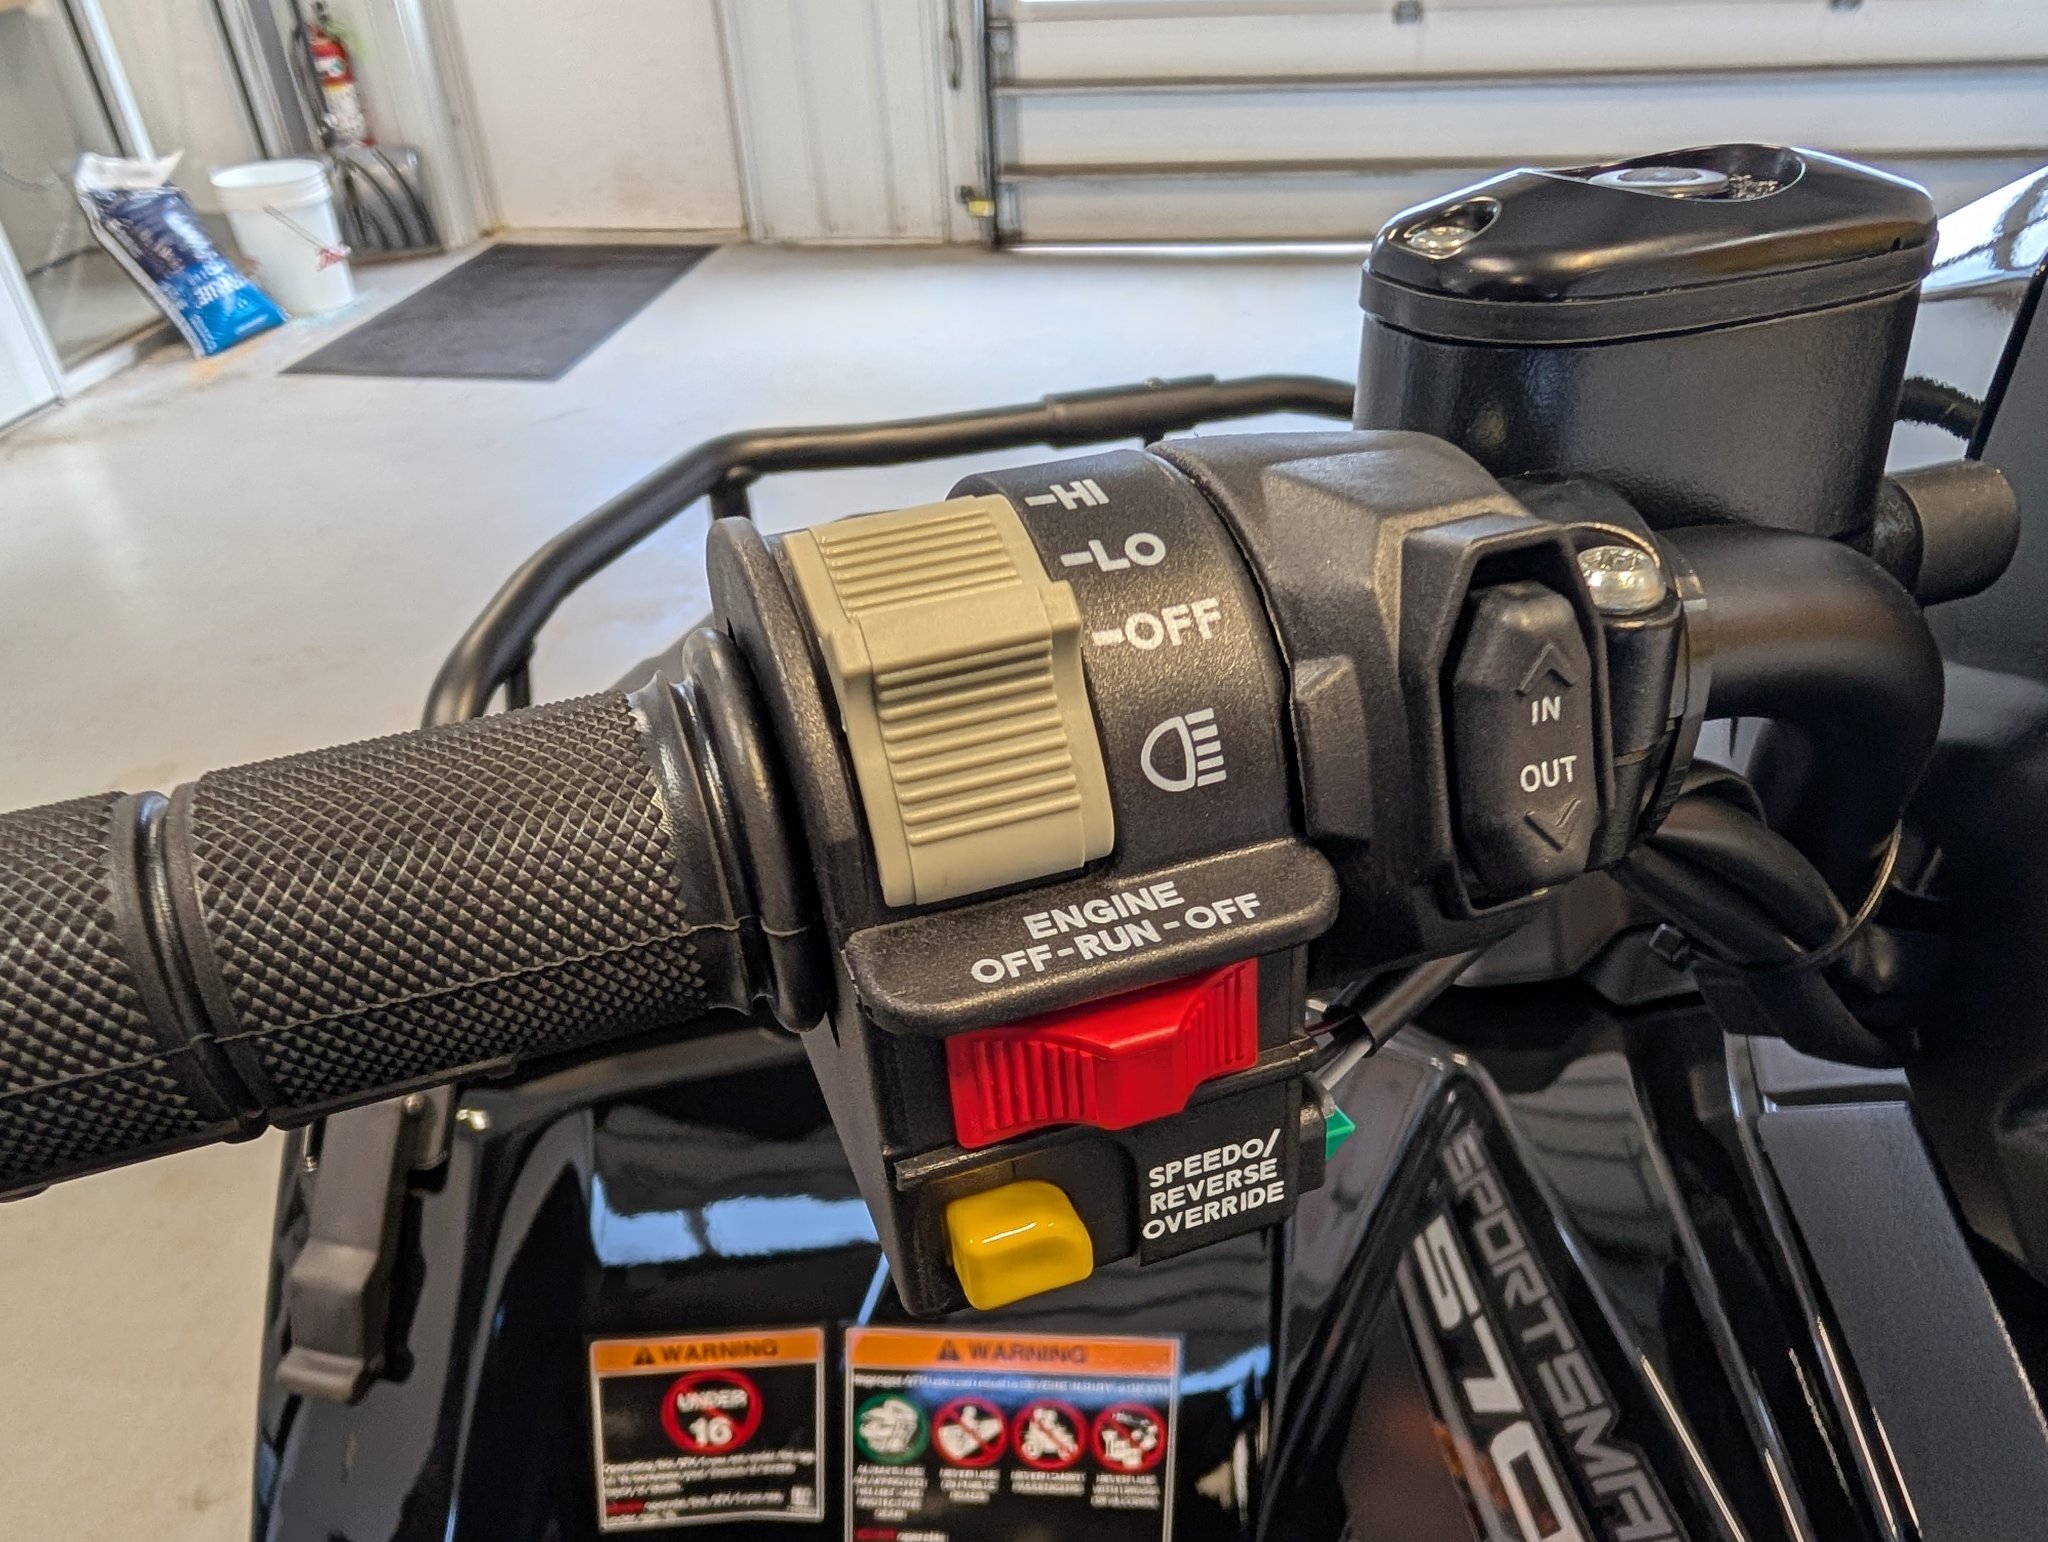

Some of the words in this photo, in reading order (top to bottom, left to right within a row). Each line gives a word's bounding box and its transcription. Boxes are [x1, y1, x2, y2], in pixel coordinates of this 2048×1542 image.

[1531, 696, 1561, 726] IN
[1520, 755, 1577, 792] OUT
[1023, 881, 1184, 940] ENGINE
[1149, 1128, 1281, 1188] SPEEDO/
[1150, 1158, 1277, 1214] REVERSE
[1142, 1180, 1284, 1240] OVERRIDE
[661, 1339, 779, 1363] WARNING
[969, 1342, 1088, 1364] WARNING
[1442, 1130, 1680, 1542] SPORTSMA
[689, 1417, 733, 1448] 16
